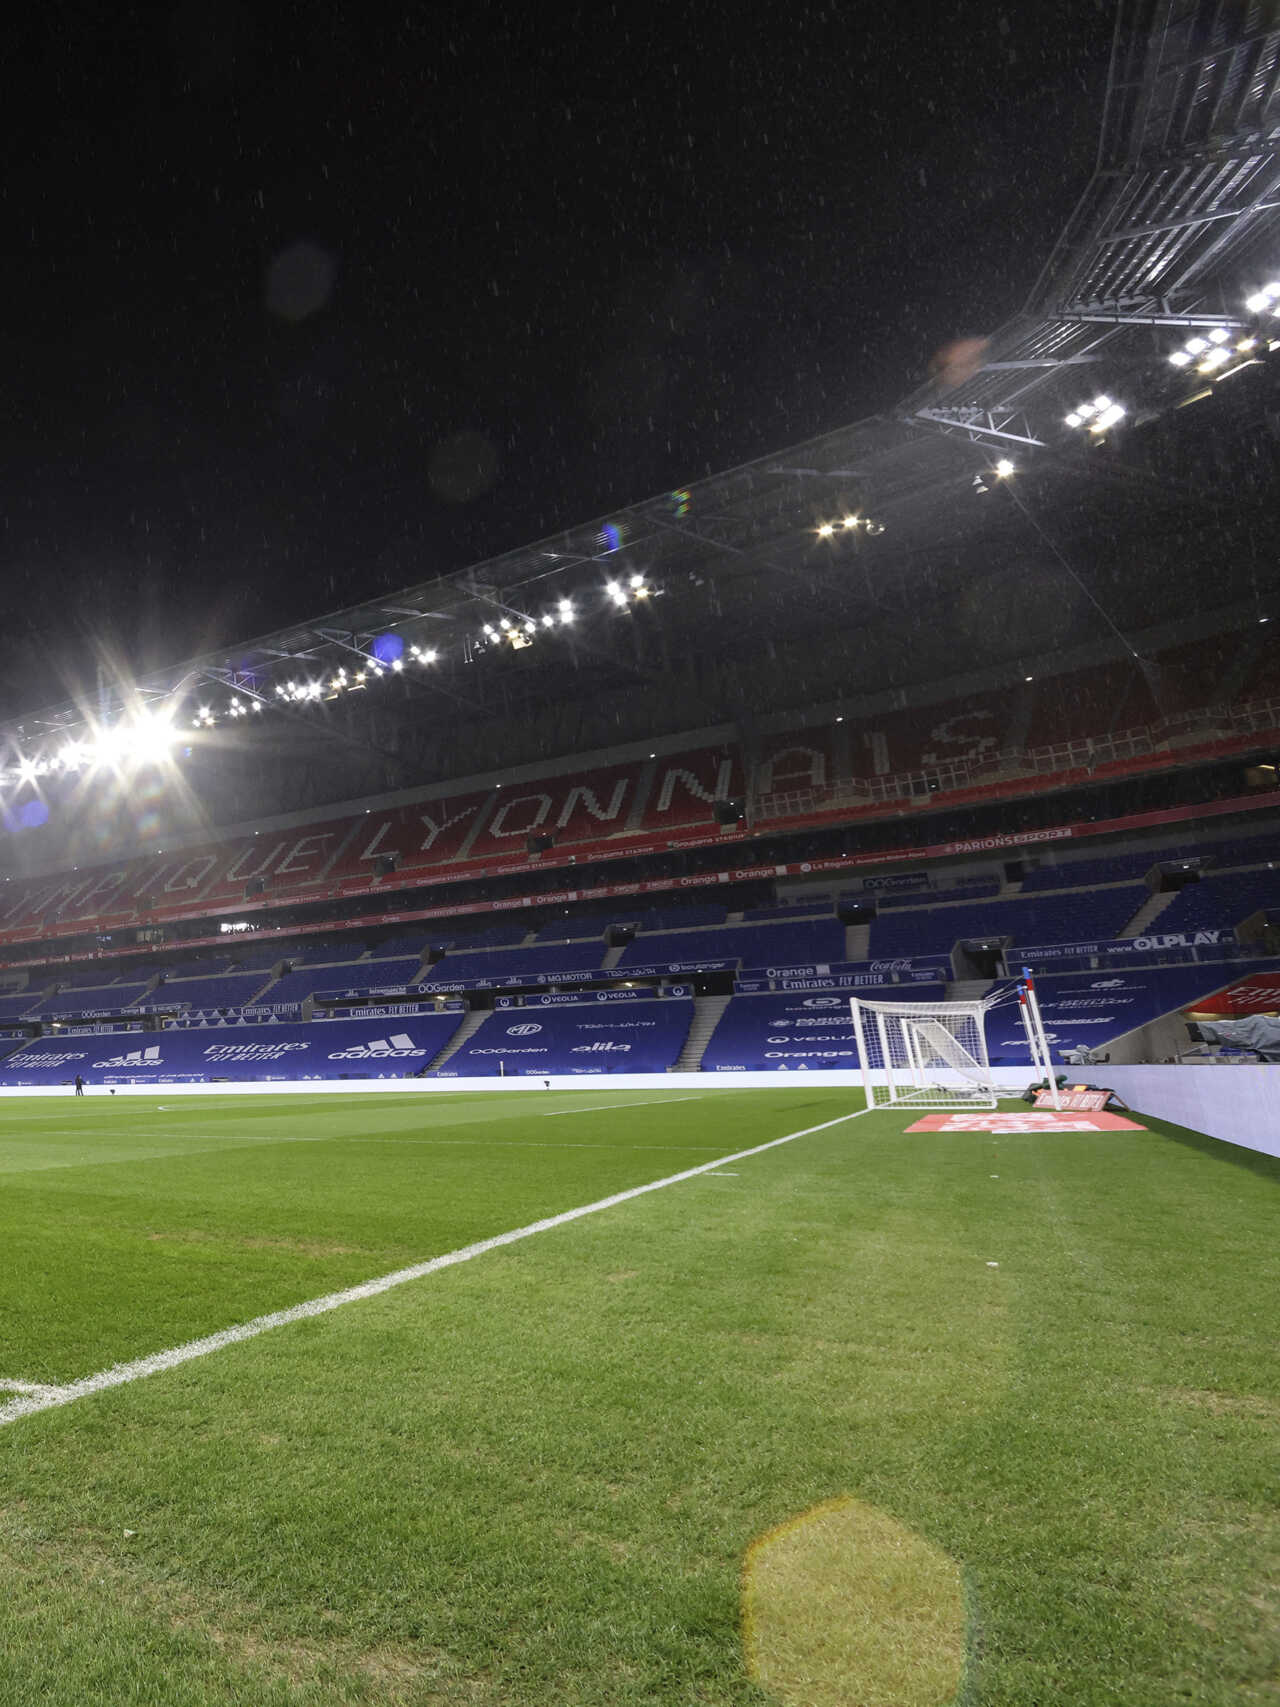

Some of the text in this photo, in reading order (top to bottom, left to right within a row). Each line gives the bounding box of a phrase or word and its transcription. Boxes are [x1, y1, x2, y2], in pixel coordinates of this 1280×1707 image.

[360, 710, 997, 861] LYONNAIS
[953, 837, 1012, 853] PARIONS
[735, 867, 774, 879] Orange
[680, 874, 716, 887] Orange
[537, 894, 568, 905] Orange
[1133, 931, 1220, 951] OLPLAY
[1020, 949, 1062, 960] Emirates
[766, 967, 814, 979] Orange
[782, 974, 884, 990] Emirates FLY BETTER
[607, 991, 637, 999] VEOLIA
[349, 1008, 386, 1017] Emirates
[203, 1042, 312, 1055] Emirates
[327, 1048, 427, 1059] adidas
[469, 1047, 548, 1055] OOGarden
[764, 1050, 853, 1058] Orange
[7, 1052, 89, 1062] Emirates
[92, 1056, 165, 1068] adidas
[716, 1064, 746, 1072] Emirates
